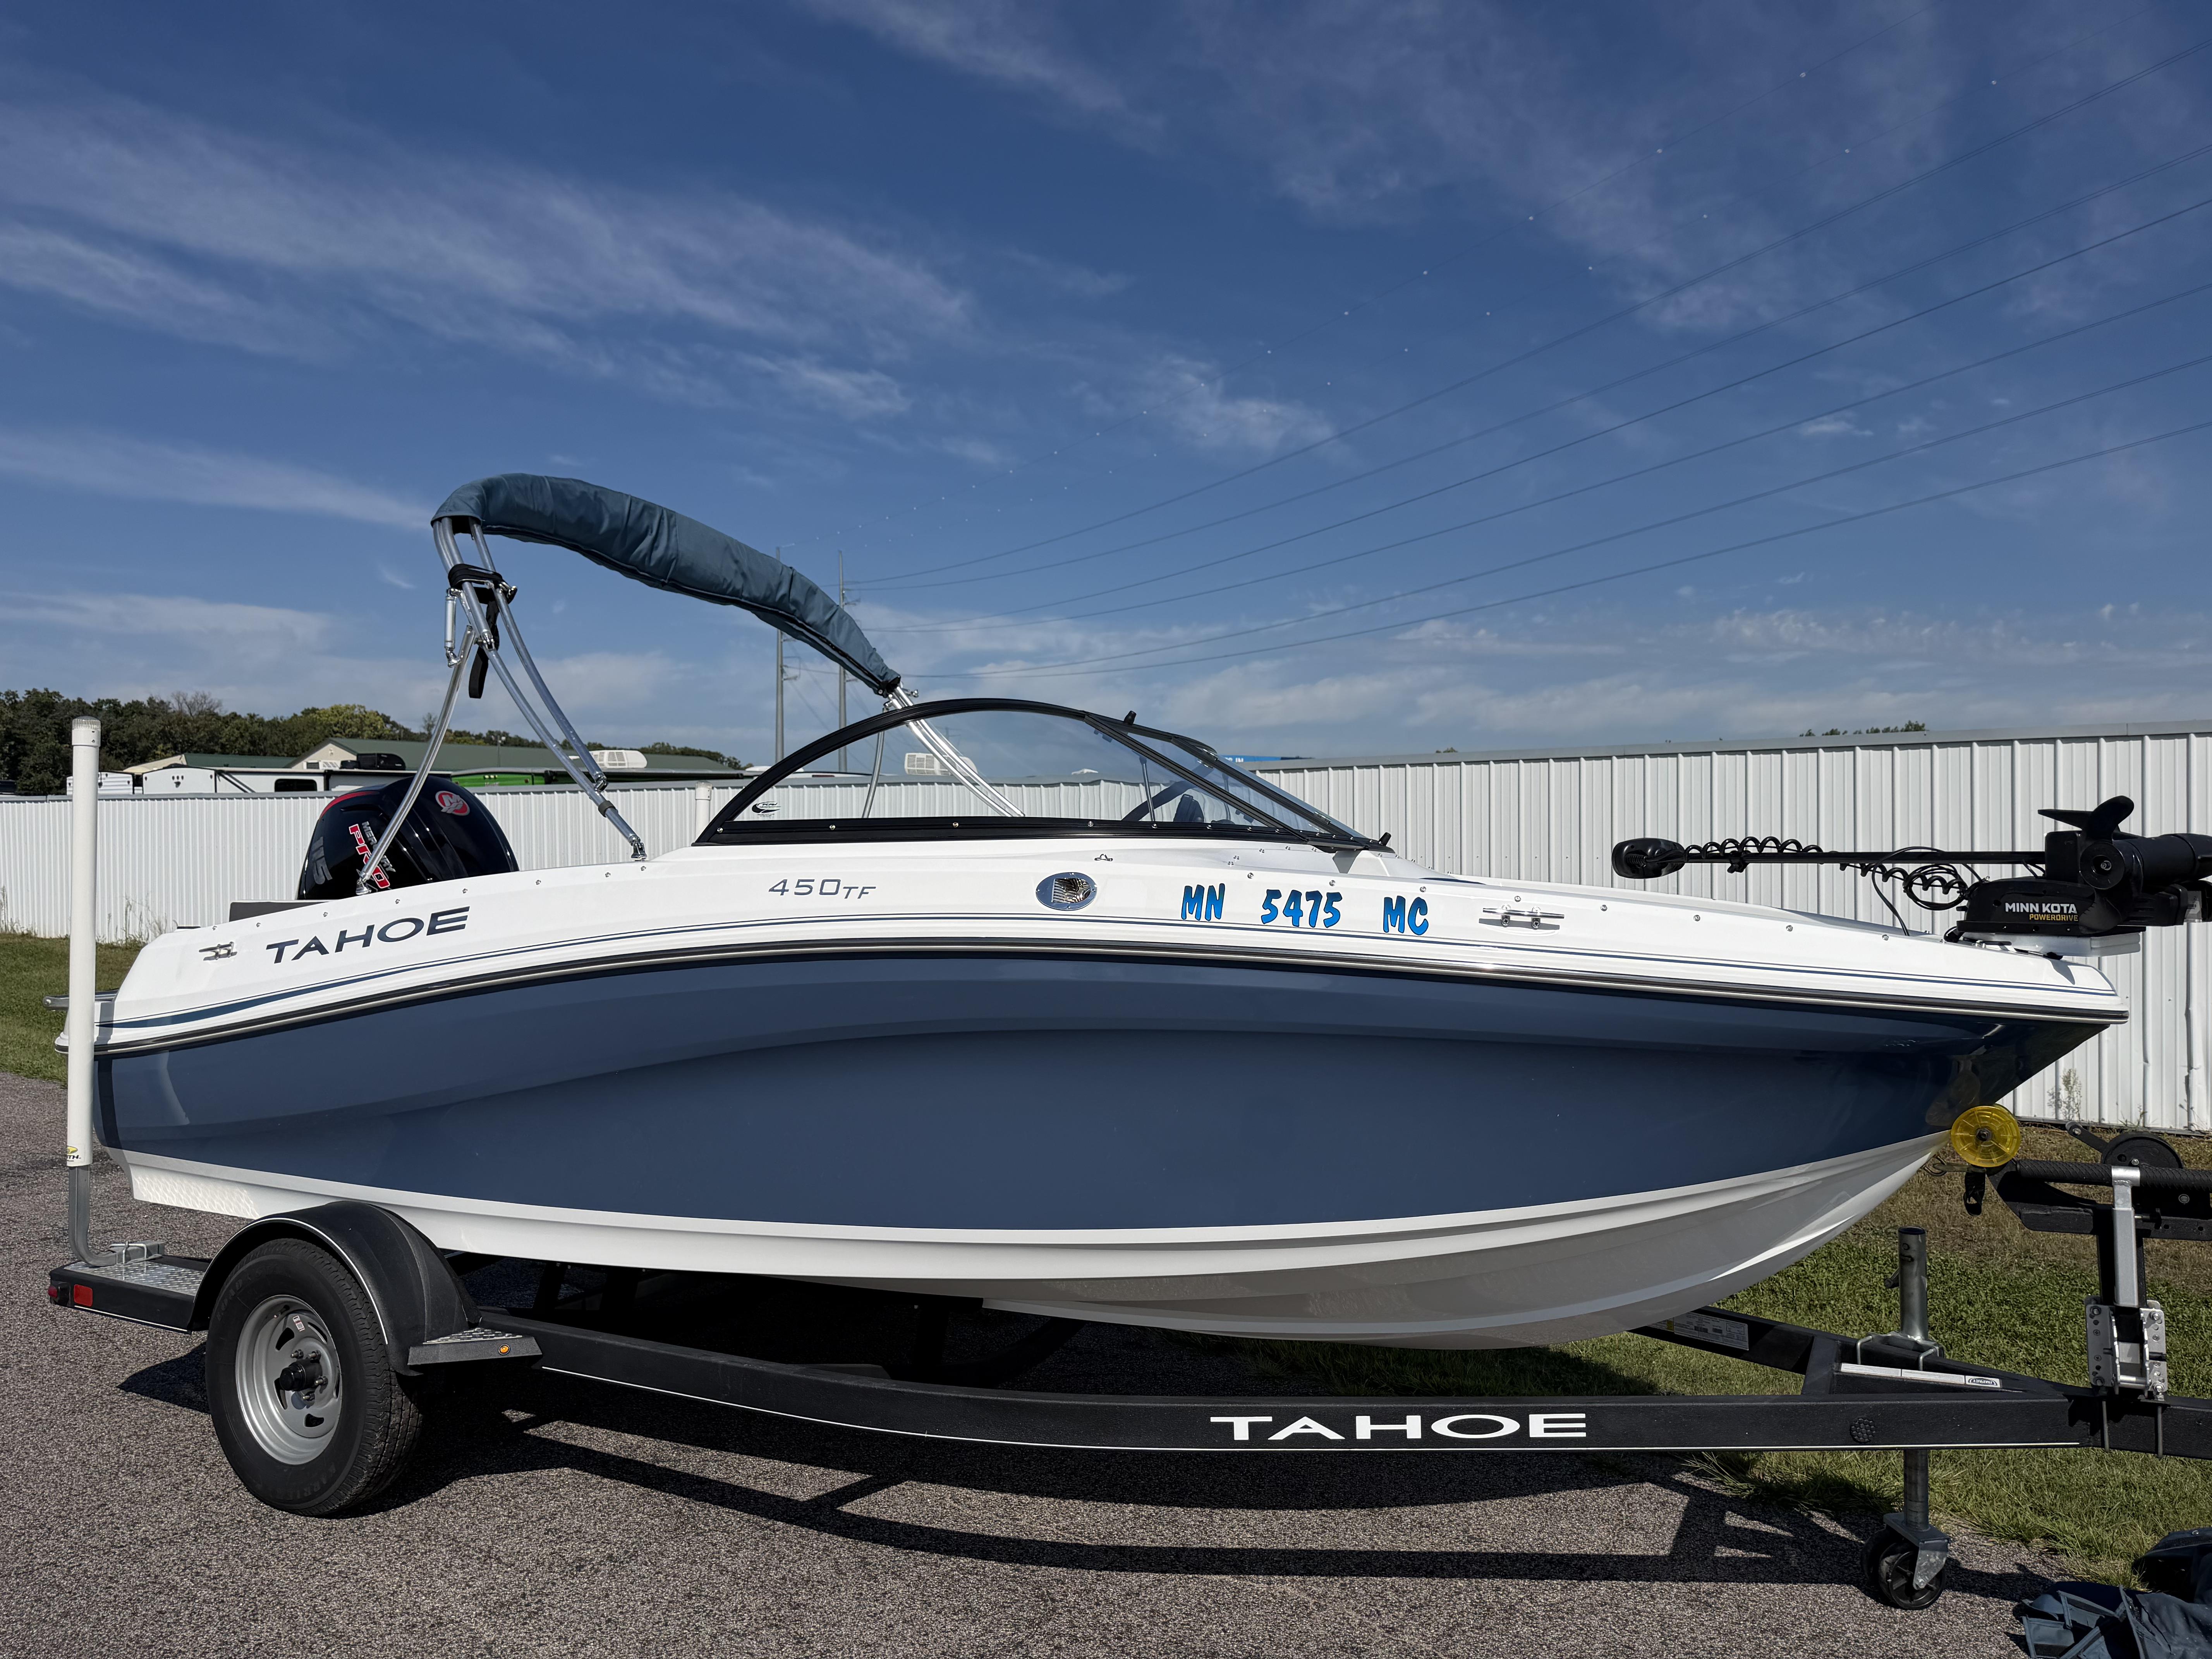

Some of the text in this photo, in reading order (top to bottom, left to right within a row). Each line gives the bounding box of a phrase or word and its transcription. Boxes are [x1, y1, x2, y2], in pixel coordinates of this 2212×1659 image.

[311, 836, 333, 885] 115
[349, 824, 390, 889] PRO
[362, 821, 396, 872] MERRY
[1181, 883, 1429, 936] MN 5475 MC
[2005, 903, 2077, 914] MINN KOTA
[266, 906, 470, 964] TAHOE
[1210, 1413, 1587, 1441] TAHOE
